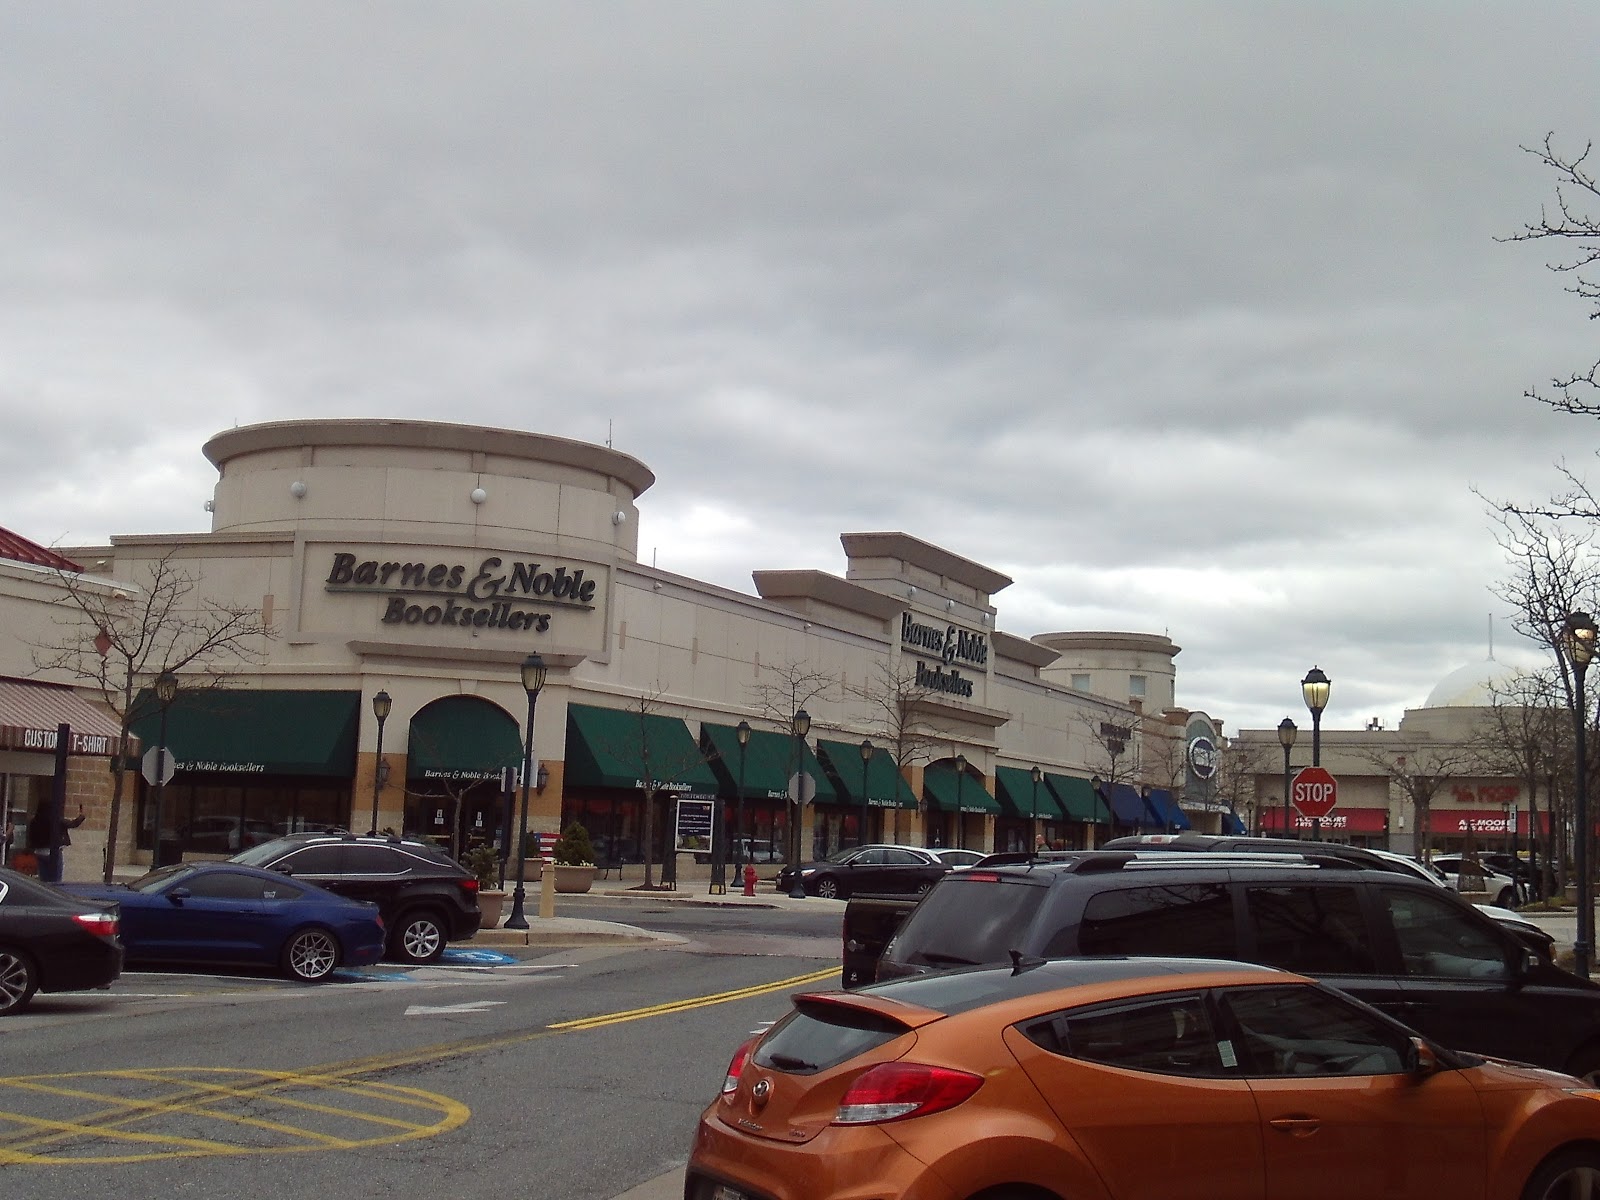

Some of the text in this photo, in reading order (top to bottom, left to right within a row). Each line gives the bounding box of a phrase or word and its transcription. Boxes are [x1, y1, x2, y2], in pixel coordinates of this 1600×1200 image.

[326, 552, 596, 601] Barnes & Noble
[381, 597, 551, 632] Booksellers
[901, 611, 944, 652] Barnes
[956, 629, 988, 664] Noble
[914, 660, 974, 698] Booksellers
[73, 734, 108, 753] T-SHIRT
[195, 761, 218, 771] Noble
[219, 762, 265, 772] Booksellers
[460, 771, 481, 779] Noble
[1295, 783, 1333, 802] STOP
